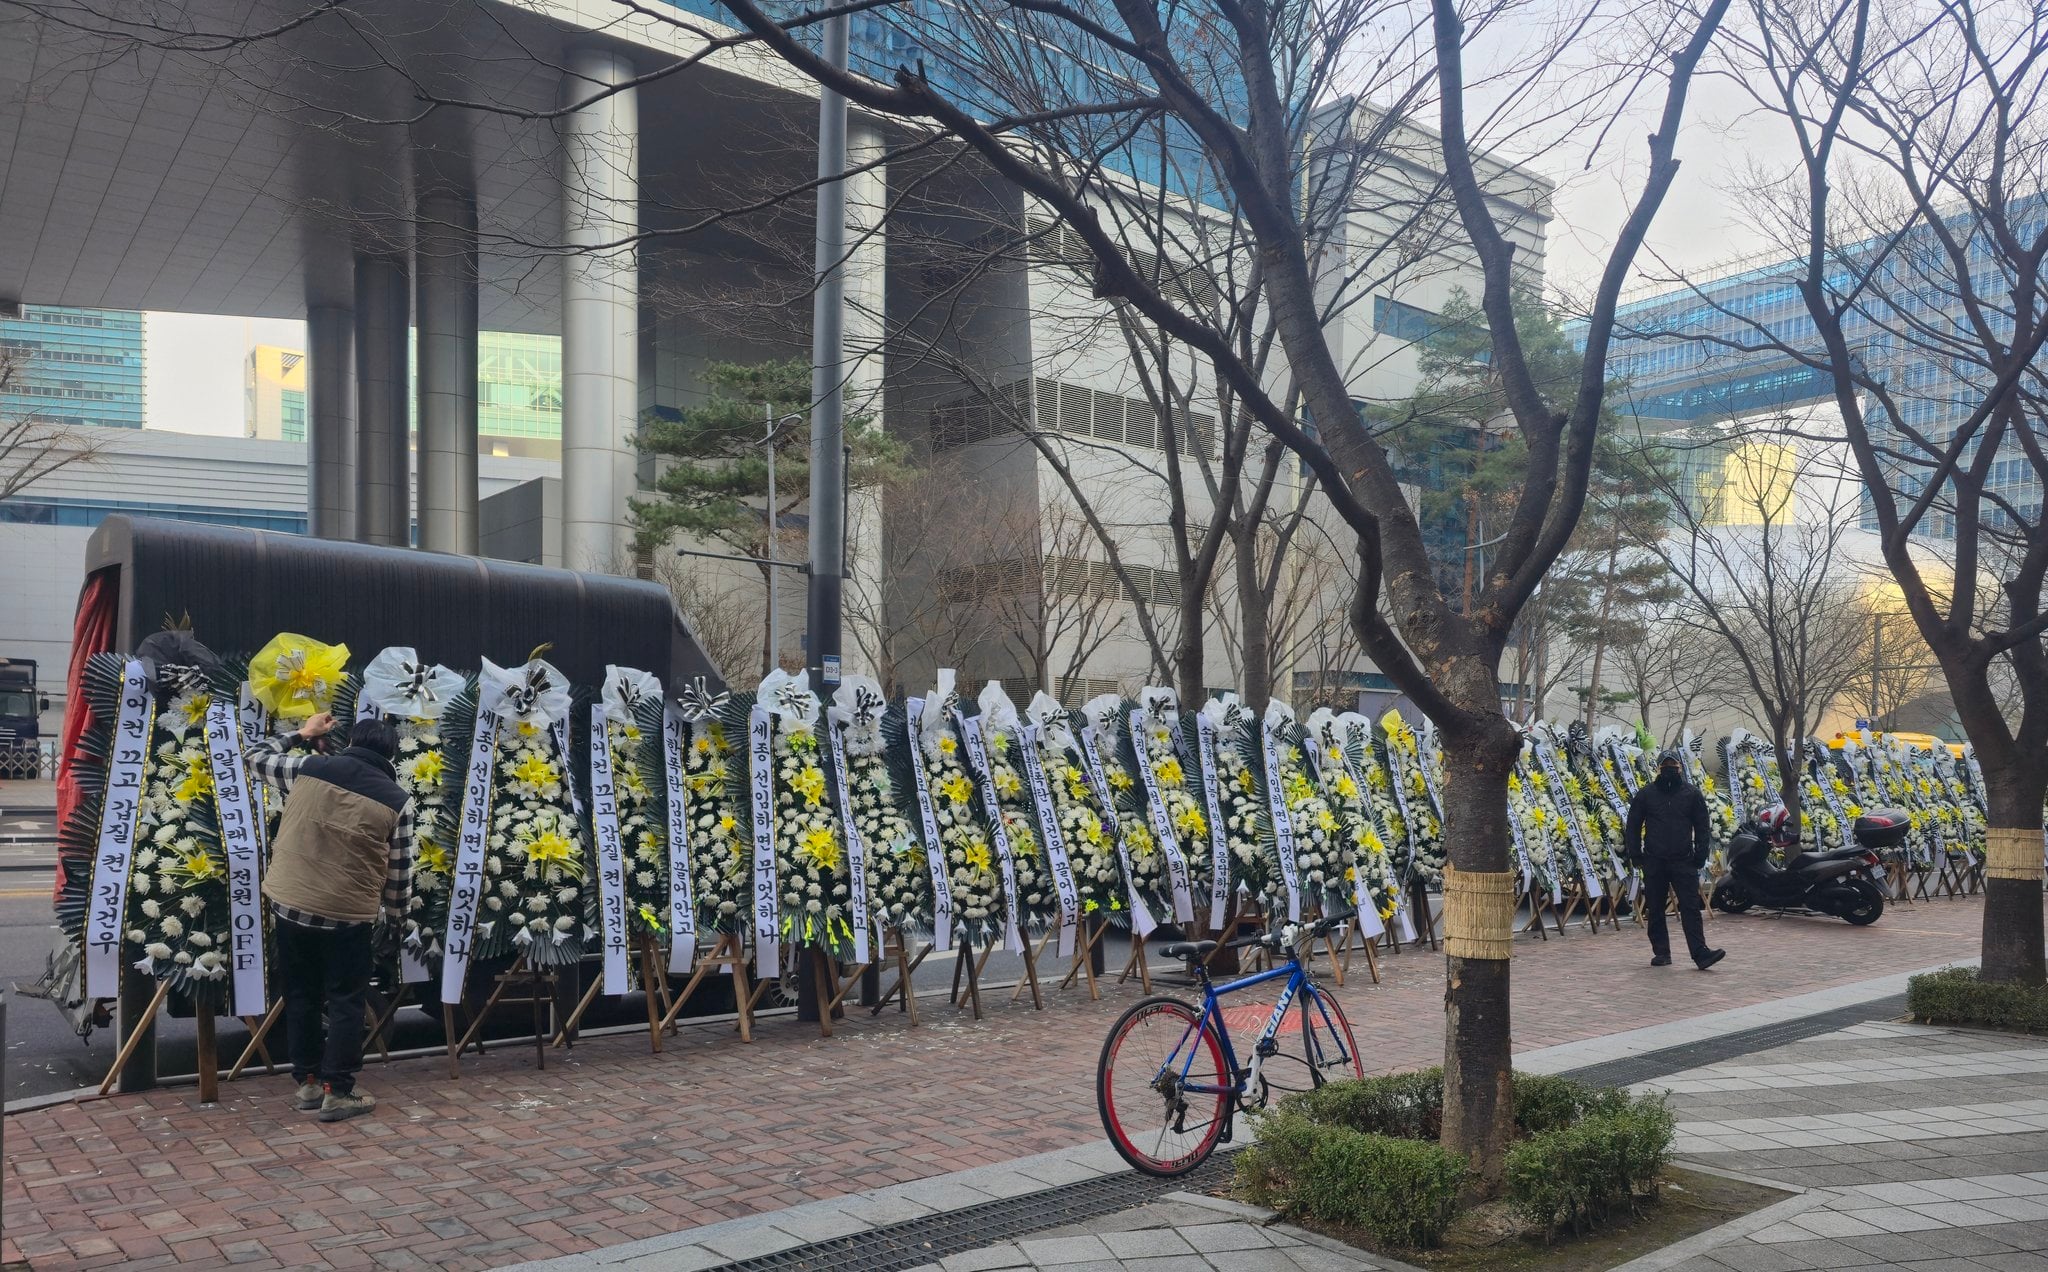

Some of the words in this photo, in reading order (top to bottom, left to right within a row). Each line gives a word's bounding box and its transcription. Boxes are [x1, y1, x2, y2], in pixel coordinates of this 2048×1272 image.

[122, 674, 149, 739] 에어컨
[476, 709, 497, 753] 세종
[112, 749, 143, 788] 끄고
[592, 722, 607, 774] 에어컨
[665, 720, 684, 793] 시한폭탄
[752, 721, 770, 762] 세종
[213, 748, 240, 803] 알디원
[595, 783, 616, 815] 끄고
[105, 798, 138, 845] 갑질
[463, 760, 488, 853] 선임하면
[670, 799, 687, 853] 김건우
[754, 769, 774, 851] 선임하면
[969, 734, 984, 768] 자칭
[1003, 874, 1015, 917] 기획
[1134, 721, 1146, 754] 자칭
[1141, 760, 1161, 806] 글로벌
[1156, 811, 1172, 840] 5대
[1168, 845, 1190, 892] 기획사
[1268, 761, 1287, 823] 선임하면
[1279, 828, 1300, 894] 무엇하나
[222, 808, 254, 861] 미래는
[601, 824, 619, 861] 갑질
[925, 820, 940, 854] 5대
[101, 852, 126, 873] 켠
[230, 868, 253, 906] 전원
[604, 868, 619, 887] 켠
[1041, 808, 1064, 855] 김건우
[1055, 862, 1079, 928] 끌어안고
[1214, 851, 1230, 901] 응답하라
[90, 882, 120, 955] 김건우
[449, 862, 482, 963] 무엇하나
[674, 861, 694, 936] 끌어안고
[756, 859, 780, 945] 무엇하나
[851, 855, 867, 931] 끌어안고
[932, 862, 953, 920] 기획사
[234, 914, 255, 970] OFF
[606, 895, 626, 955] 김건우
[1265, 984, 1293, 1038] GIANT
